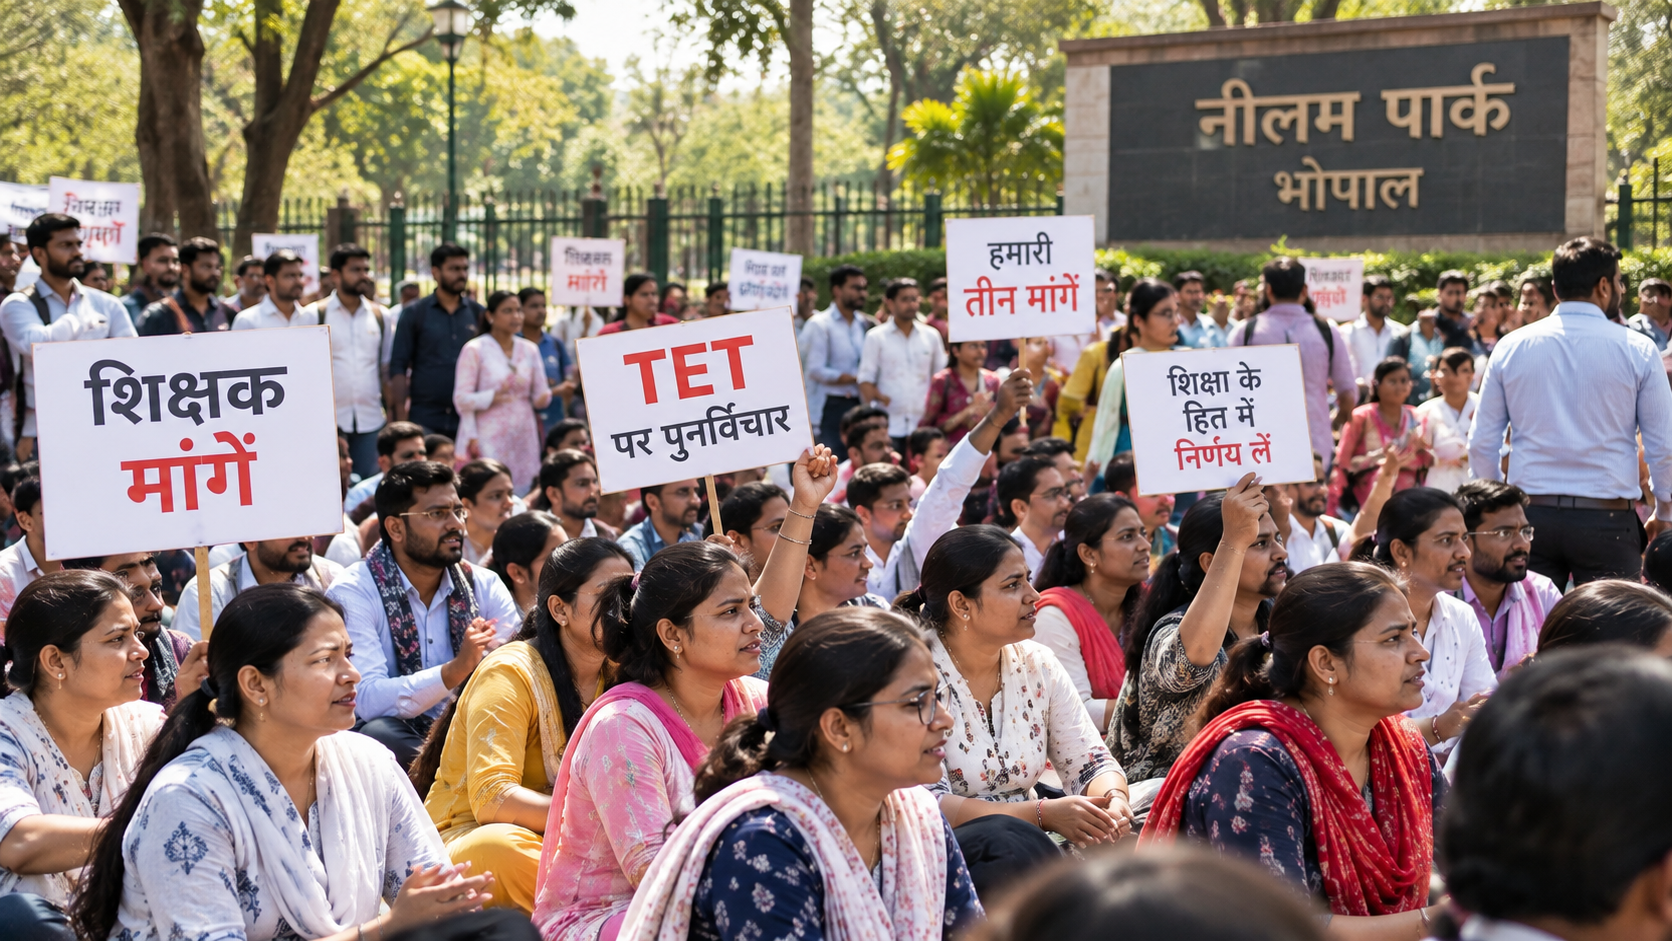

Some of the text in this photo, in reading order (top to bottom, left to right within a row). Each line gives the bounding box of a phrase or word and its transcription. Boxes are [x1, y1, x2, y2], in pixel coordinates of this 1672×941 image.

[1195, 63, 1515, 146] नीलम पार्क
[1274, 156, 1424, 210] भोपाल
[987, 231, 1054, 270] हमारी
[964, 272, 1080, 317] तीन मांगें
[83, 359, 288, 426] शिक्षक
[622, 334, 754, 405] TET
[1166, 361, 1262, 397] शिक्षा के
[610, 402, 792, 463] पर पुनर्विचार
[1183, 396, 1256, 435] हित में
[120, 430, 258, 514] मांगें
[1173, 432, 1272, 471] निर्णय लें
